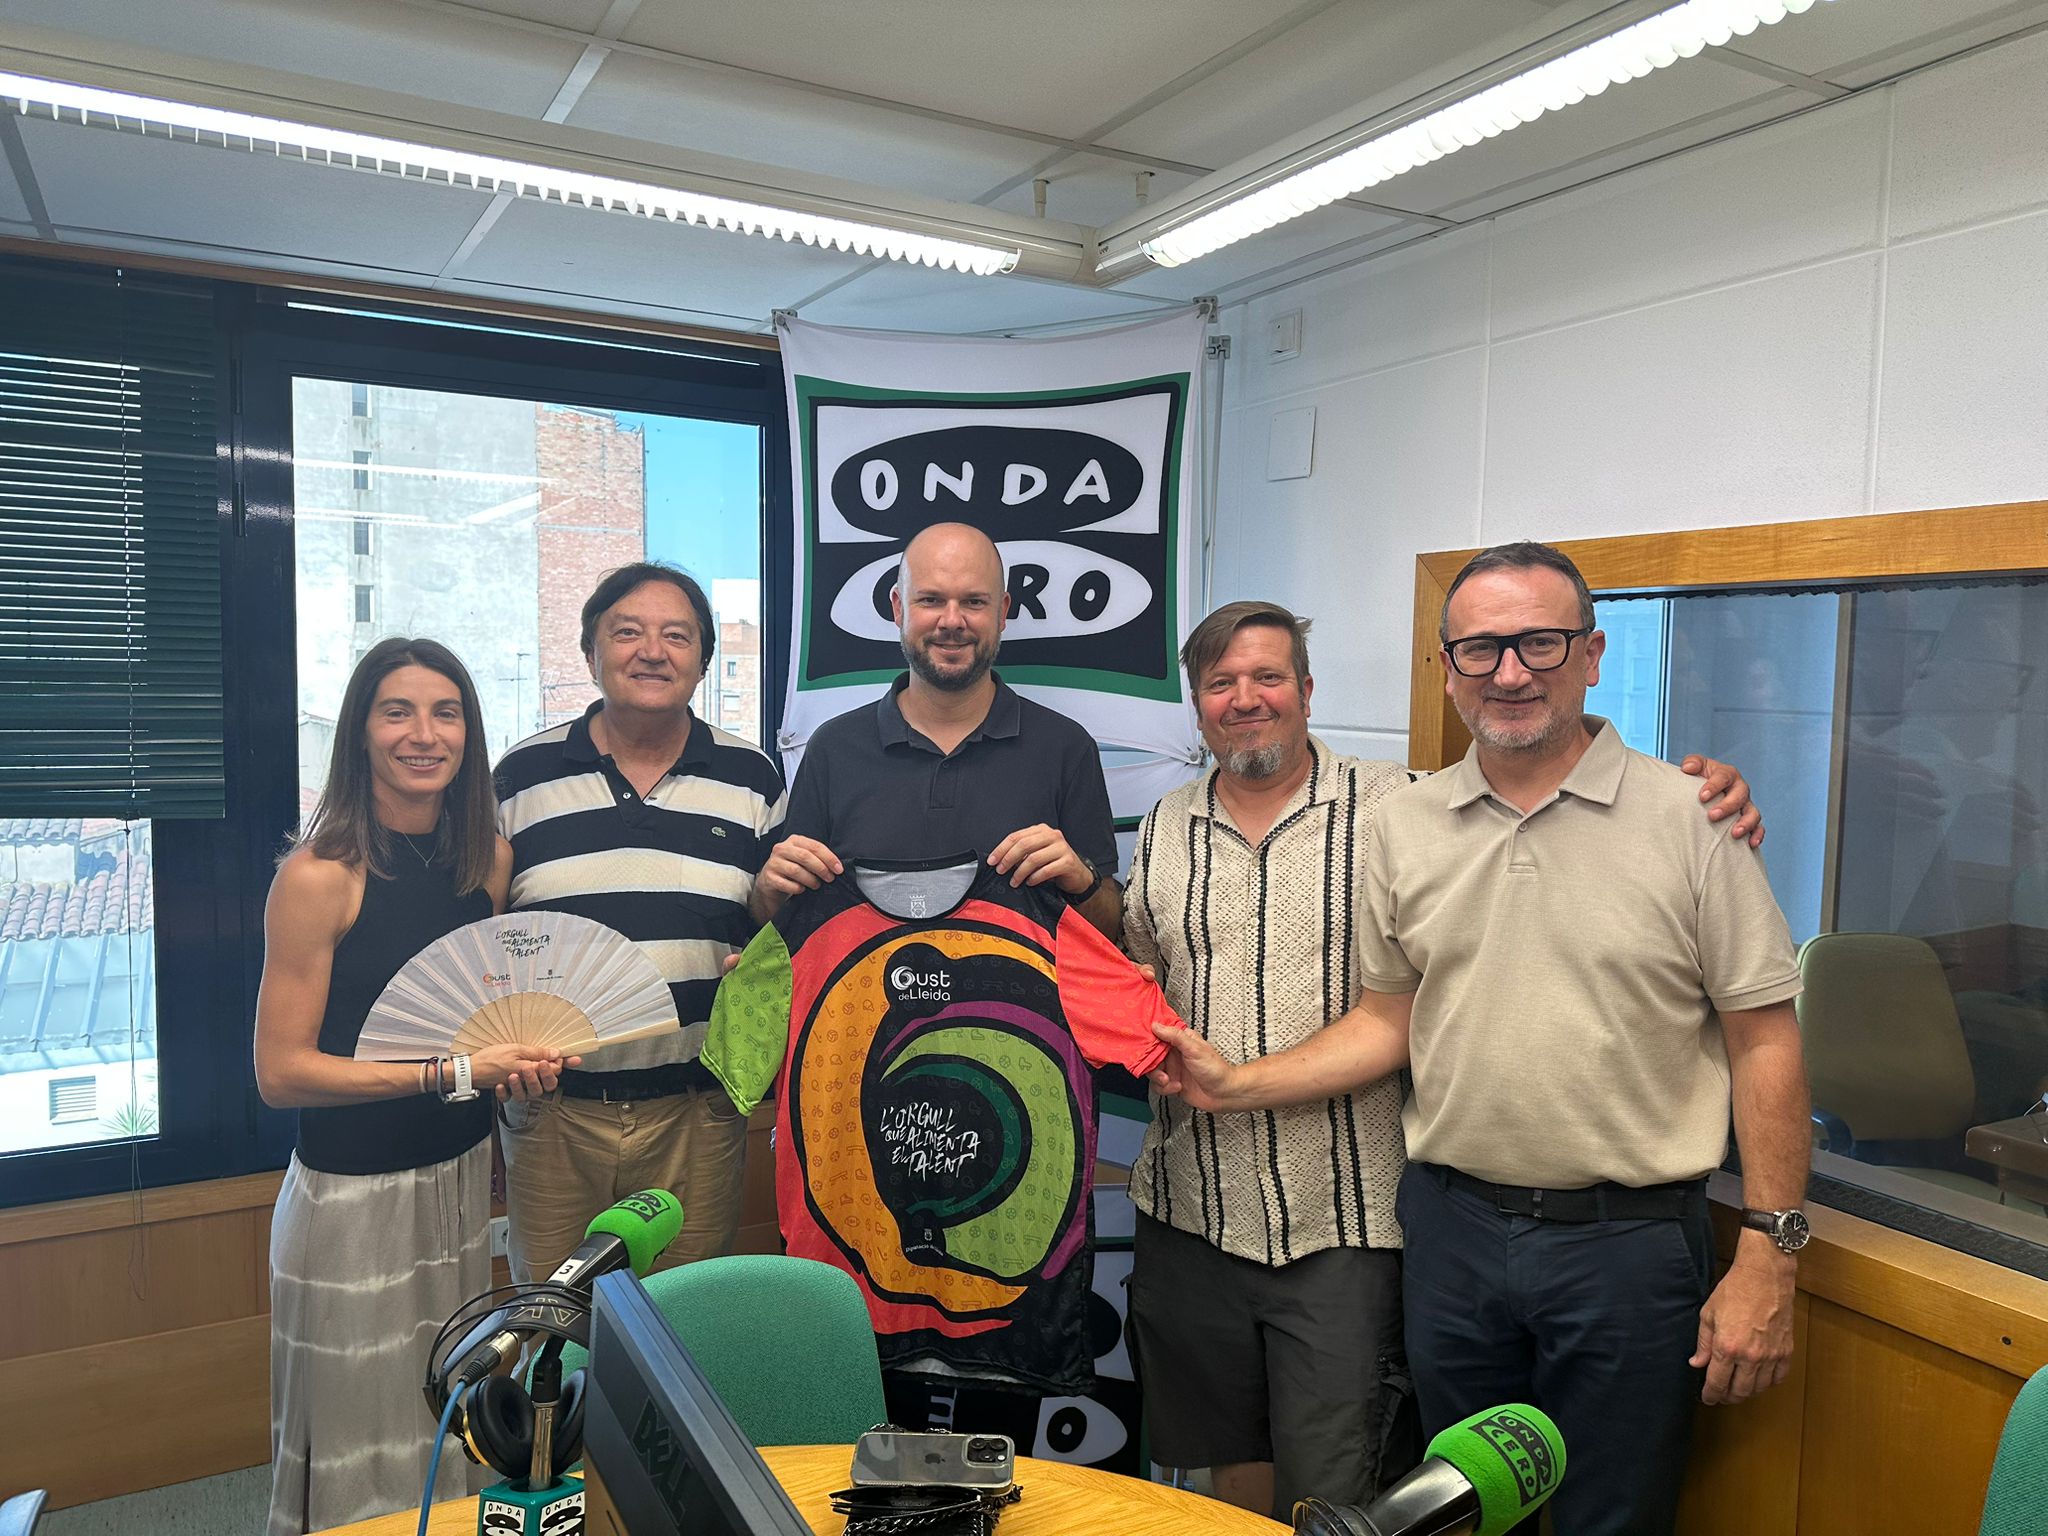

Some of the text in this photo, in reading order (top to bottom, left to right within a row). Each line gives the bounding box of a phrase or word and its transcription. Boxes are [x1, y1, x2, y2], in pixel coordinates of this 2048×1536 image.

[860, 459, 1111, 511] ONDA
[872, 563, 1111, 622] CRO
[511, 934, 551, 948] ALIMENTA
[511, 945, 545, 959] TALENT
[880, 1102, 957, 1132] L'ORGULL
[885, 1126, 981, 1159] QUE ALIMENTA
[892, 1146, 976, 1182] EL TALENT
[558, 1264, 574, 1275] 3
[1491, 1429, 1535, 1488] CERO
[1505, 1418, 1549, 1478] ONDA
[488, 1502, 521, 1517] ONDA
[546, 1494, 582, 1515] ONDA
